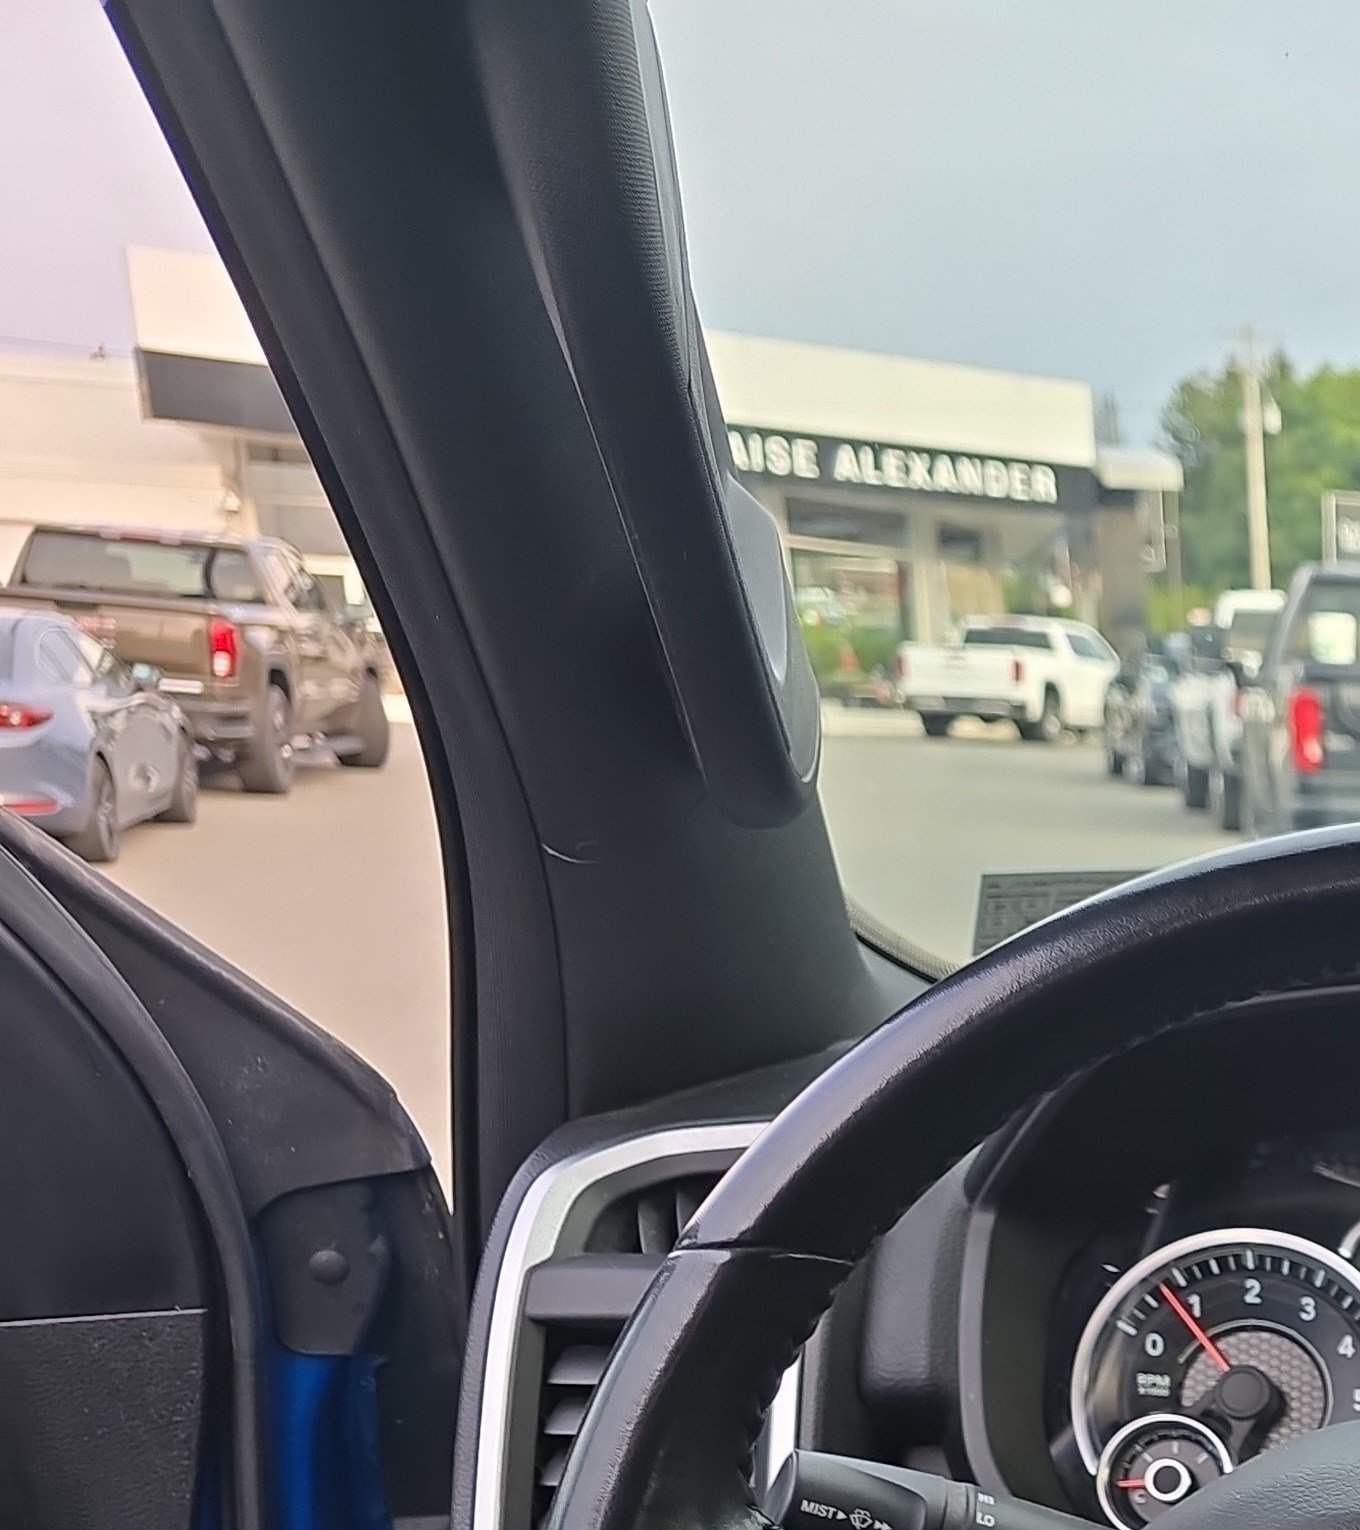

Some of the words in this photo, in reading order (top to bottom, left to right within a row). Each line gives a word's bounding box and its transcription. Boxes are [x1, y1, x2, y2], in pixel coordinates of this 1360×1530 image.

[833, 443, 1059, 504] ALEXANDER
[1243, 1278, 1262, 1304] 2
[1187, 1295, 1202, 1317] 1
[1299, 1298, 1317, 1321] 3
[1144, 1332, 1165, 1357] 0
[1337, 1335, 1355, 1359] 4
[1136, 1372, 1171, 1388] RPM
[801, 1499, 837, 1520] MIST
